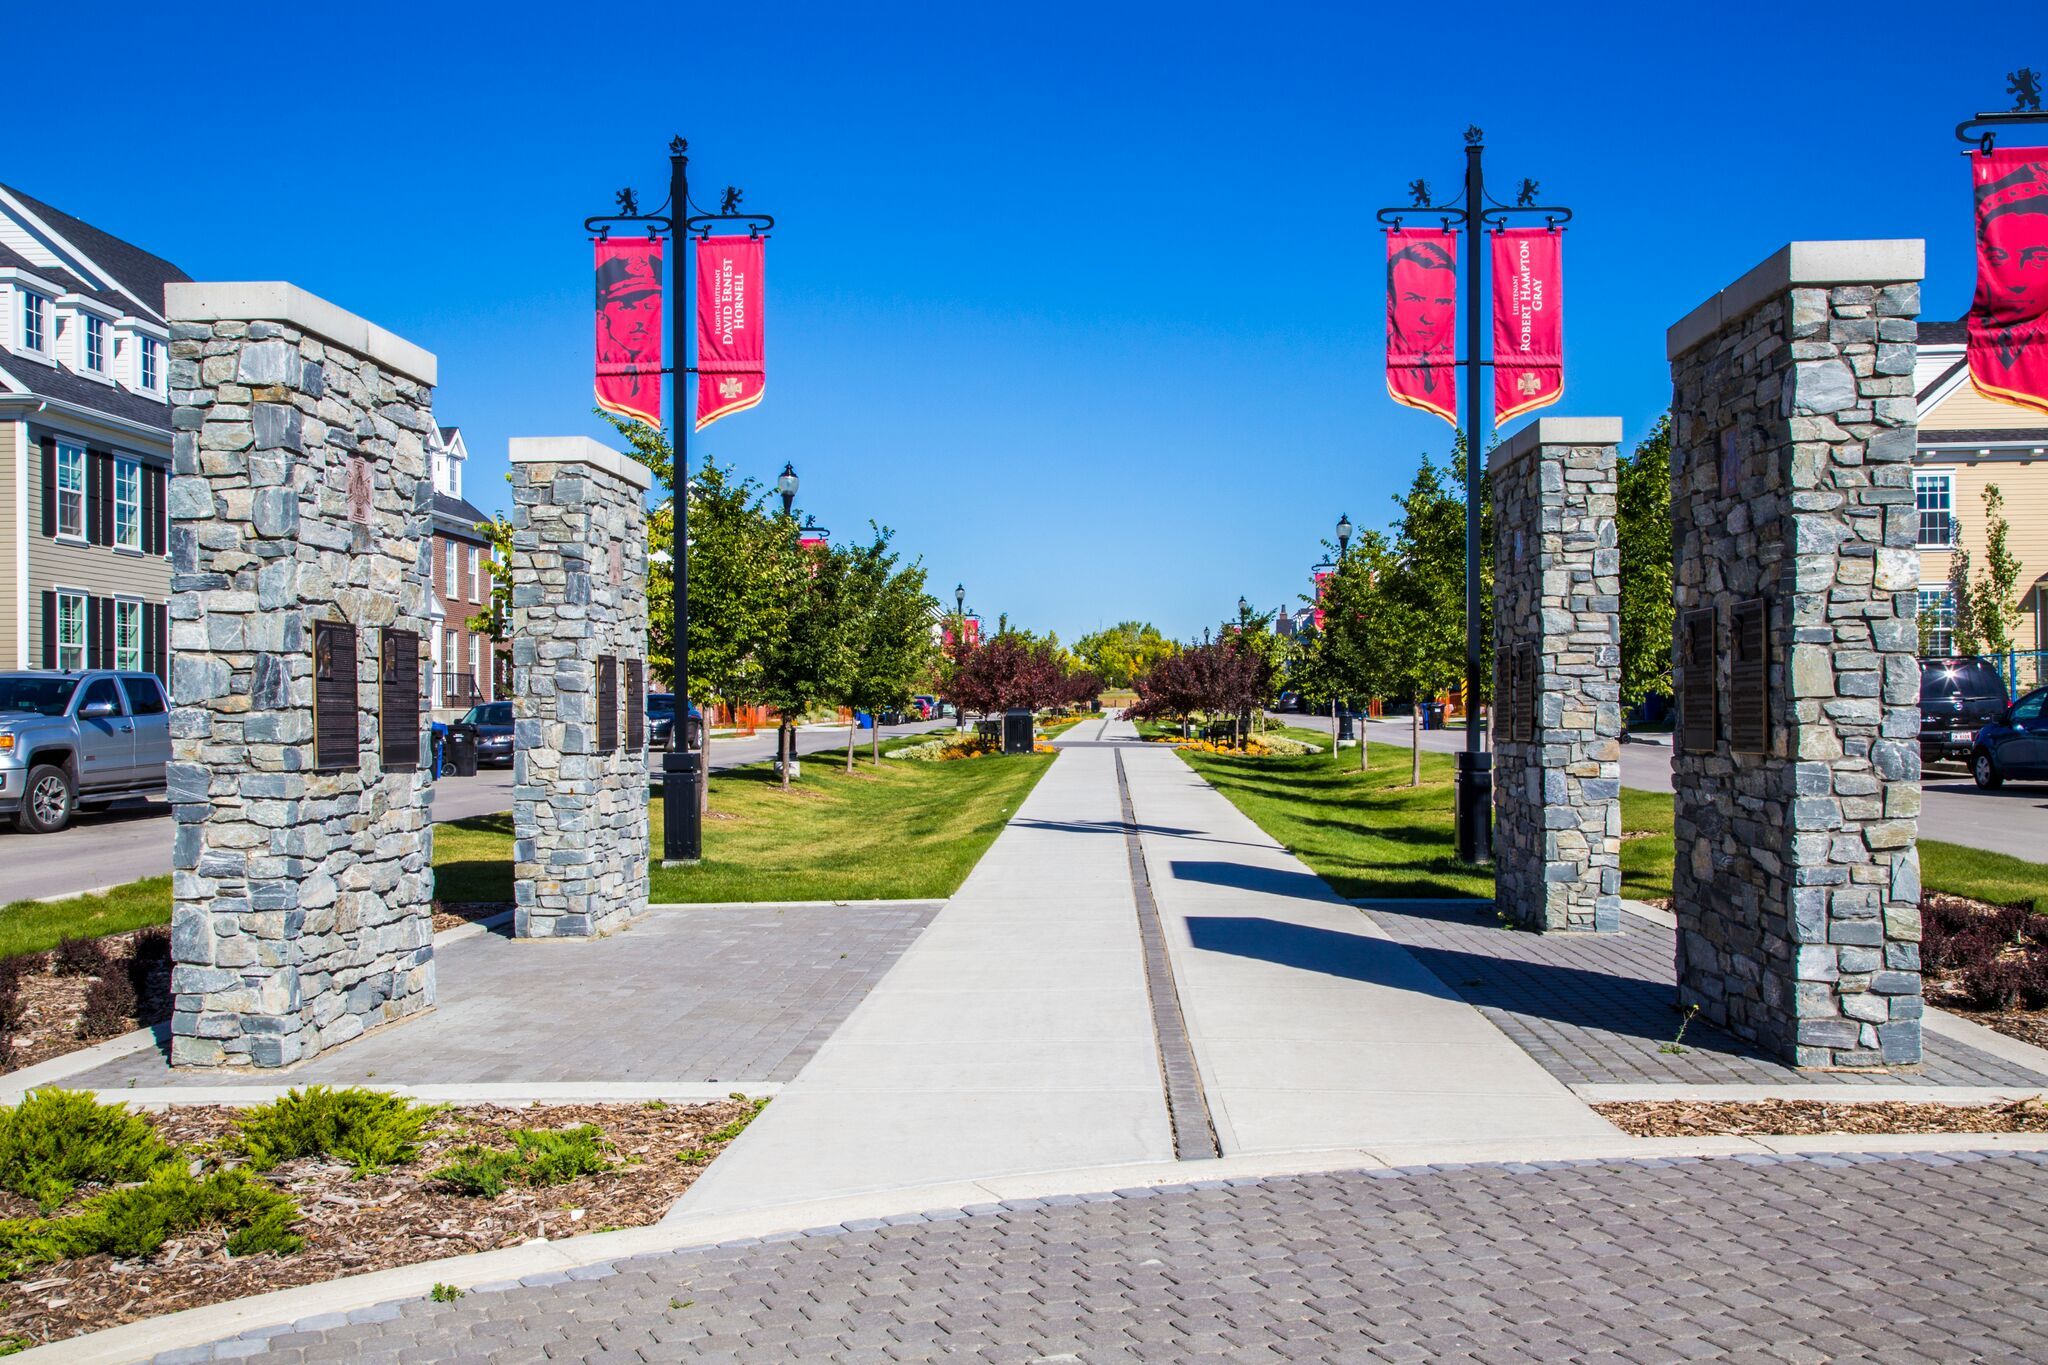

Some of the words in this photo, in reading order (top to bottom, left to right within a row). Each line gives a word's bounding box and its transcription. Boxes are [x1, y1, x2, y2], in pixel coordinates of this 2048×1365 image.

[721, 257, 733, 303] ERNEST
[1519, 240, 1531, 301] HAMPTON
[733, 272, 744, 329] HORNELL
[1531, 278, 1543, 311] GRAY
[722, 305, 733, 345] DAVID
[1520, 304, 1531, 351] ROBERT
